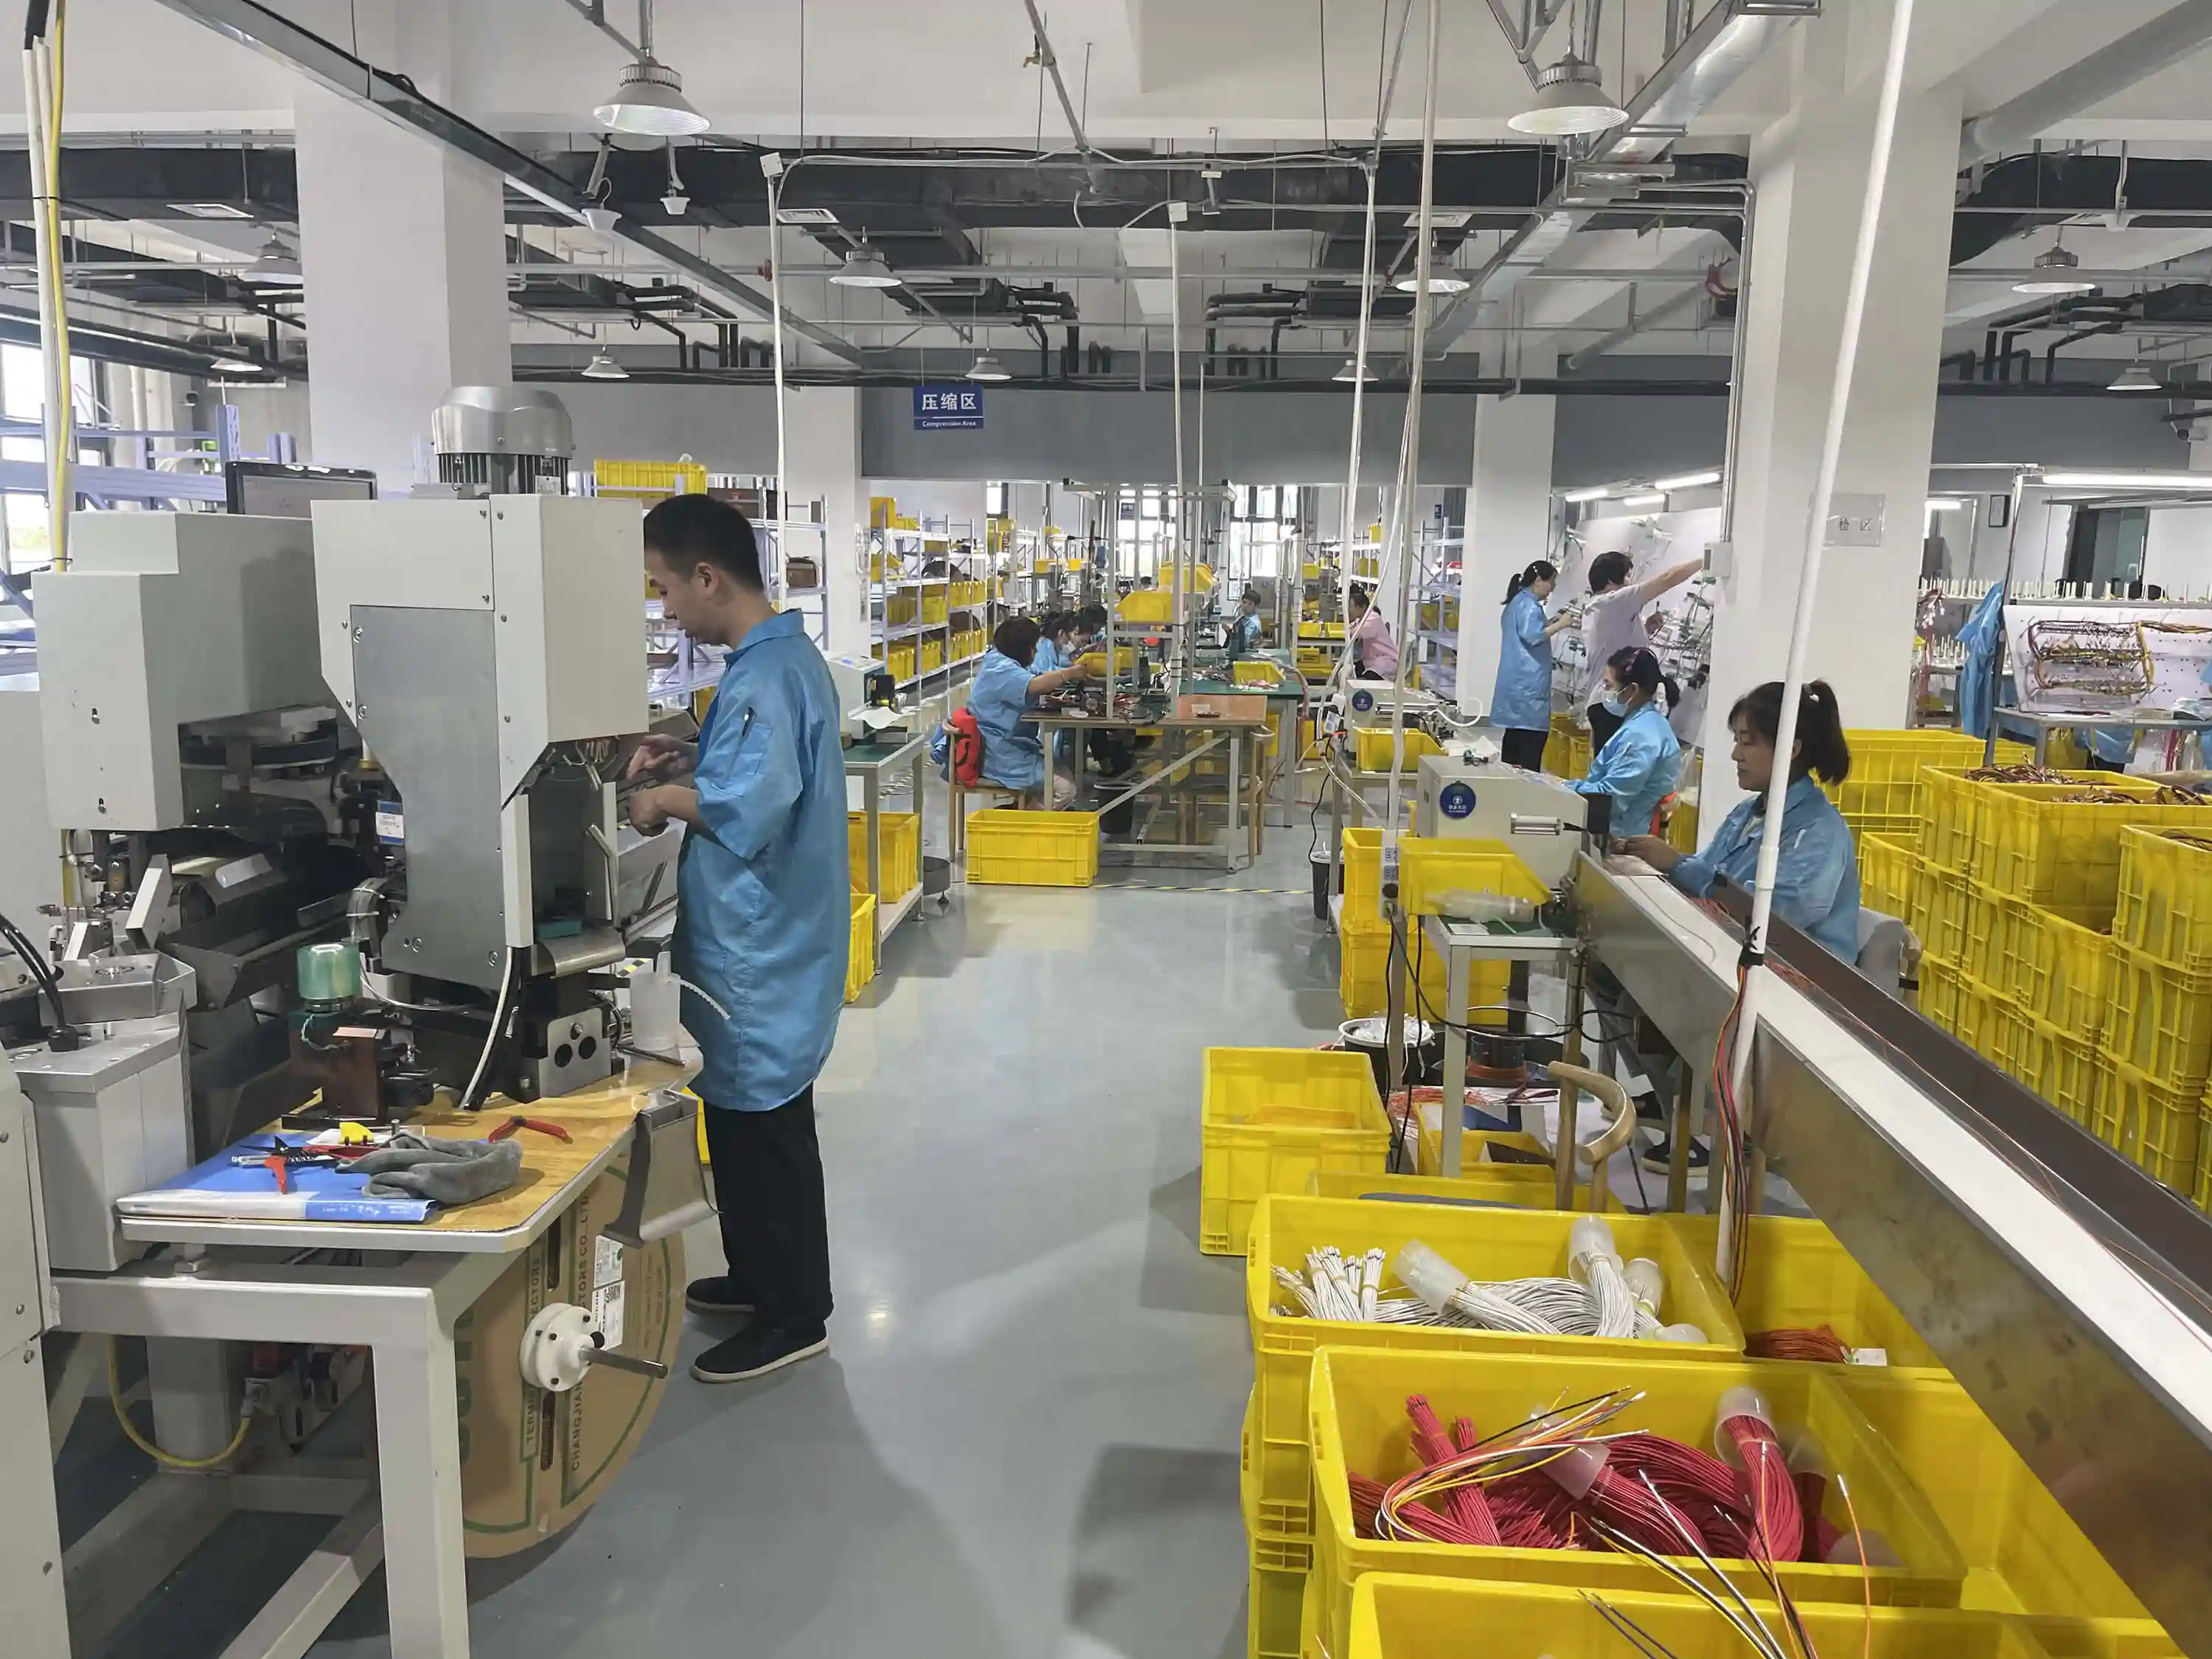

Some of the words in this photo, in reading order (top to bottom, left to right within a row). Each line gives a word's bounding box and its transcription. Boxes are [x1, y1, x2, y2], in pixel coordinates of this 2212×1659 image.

[922, 393, 976, 411] 压缩区
[530, 1257, 540, 1315] ECTORS
[571, 1381, 583, 1471] CHANGJIAN
